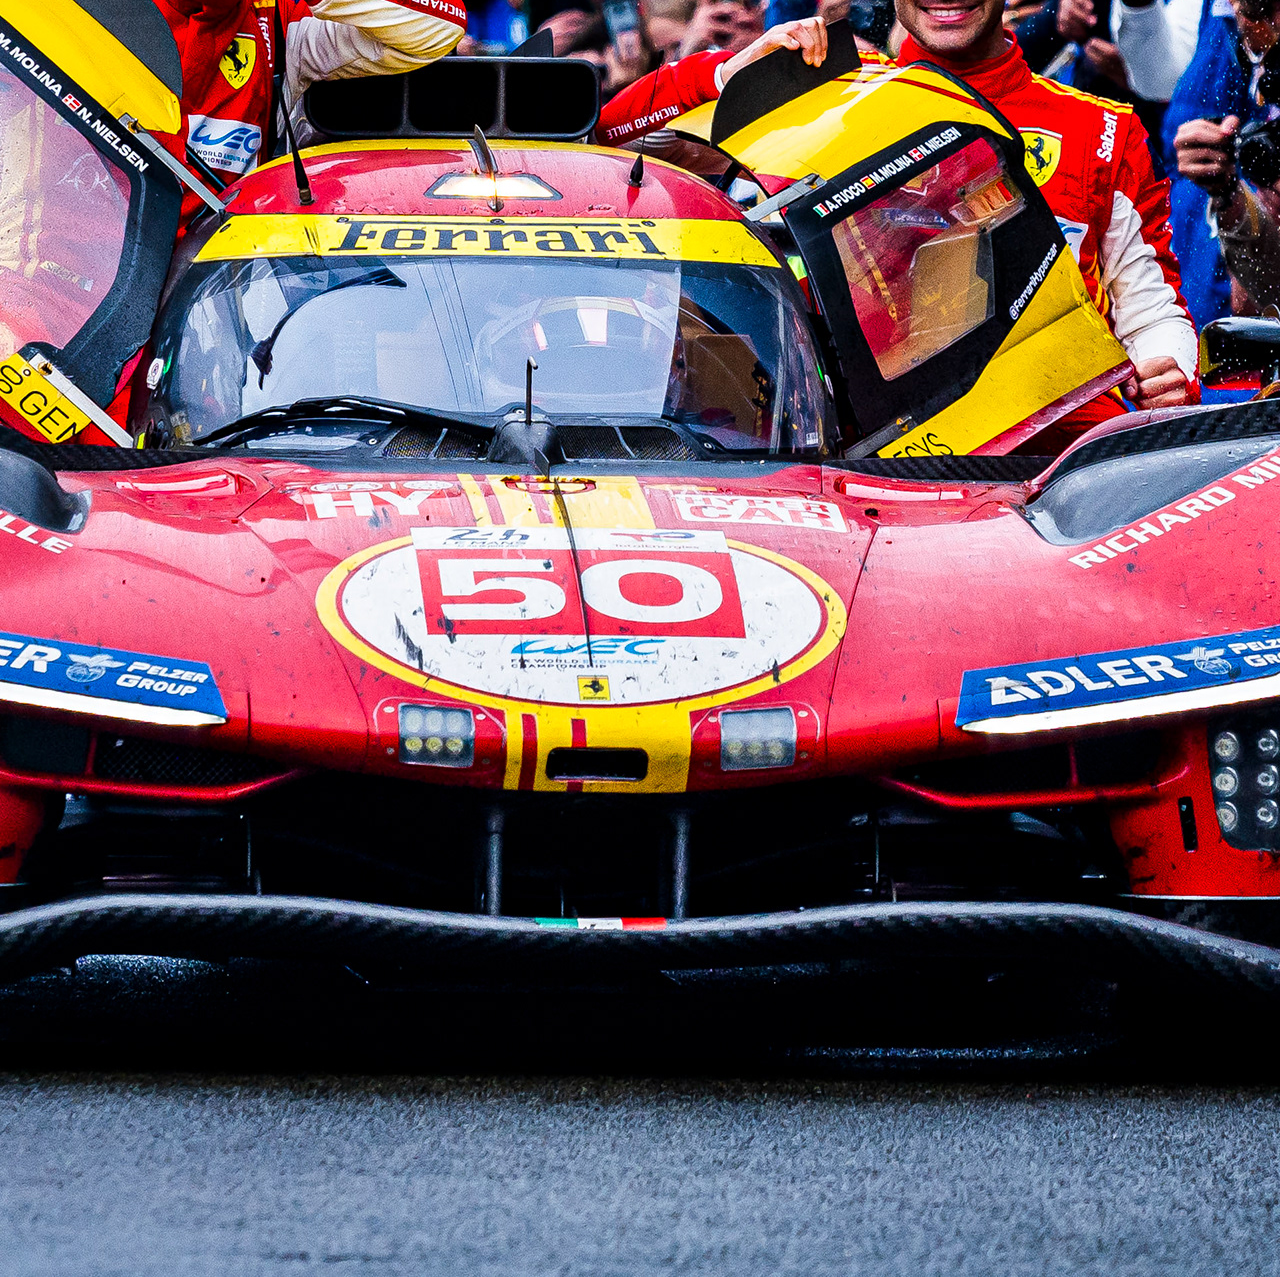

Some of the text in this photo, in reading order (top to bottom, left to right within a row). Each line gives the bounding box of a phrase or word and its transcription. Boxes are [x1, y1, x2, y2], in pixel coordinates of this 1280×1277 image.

[9, 46, 64, 97] MOLINA
[76, 106, 91, 124] N.
[90, 117, 150, 172] NIELSEN
[606, 104, 680, 140] RICHARD MILLE
[191, 124, 261, 154] WEC
[1096, 110, 1118, 163] Sabelt
[329, 217, 668, 256] Ferrari
[1009, 243, 1058, 320] @FerrariHypercar
[312, 491, 435, 518] HY
[684, 496, 830, 512] HYPER
[689, 505, 835, 529] CAR
[1068, 486, 1236, 569] RICHARD
[437, 558, 723, 623] 50
[511, 638, 667, 656] WEC
[116, 674, 198, 698] GROUP
[127, 661, 210, 685] PELZER
[984, 654, 1188, 706] ADLER
